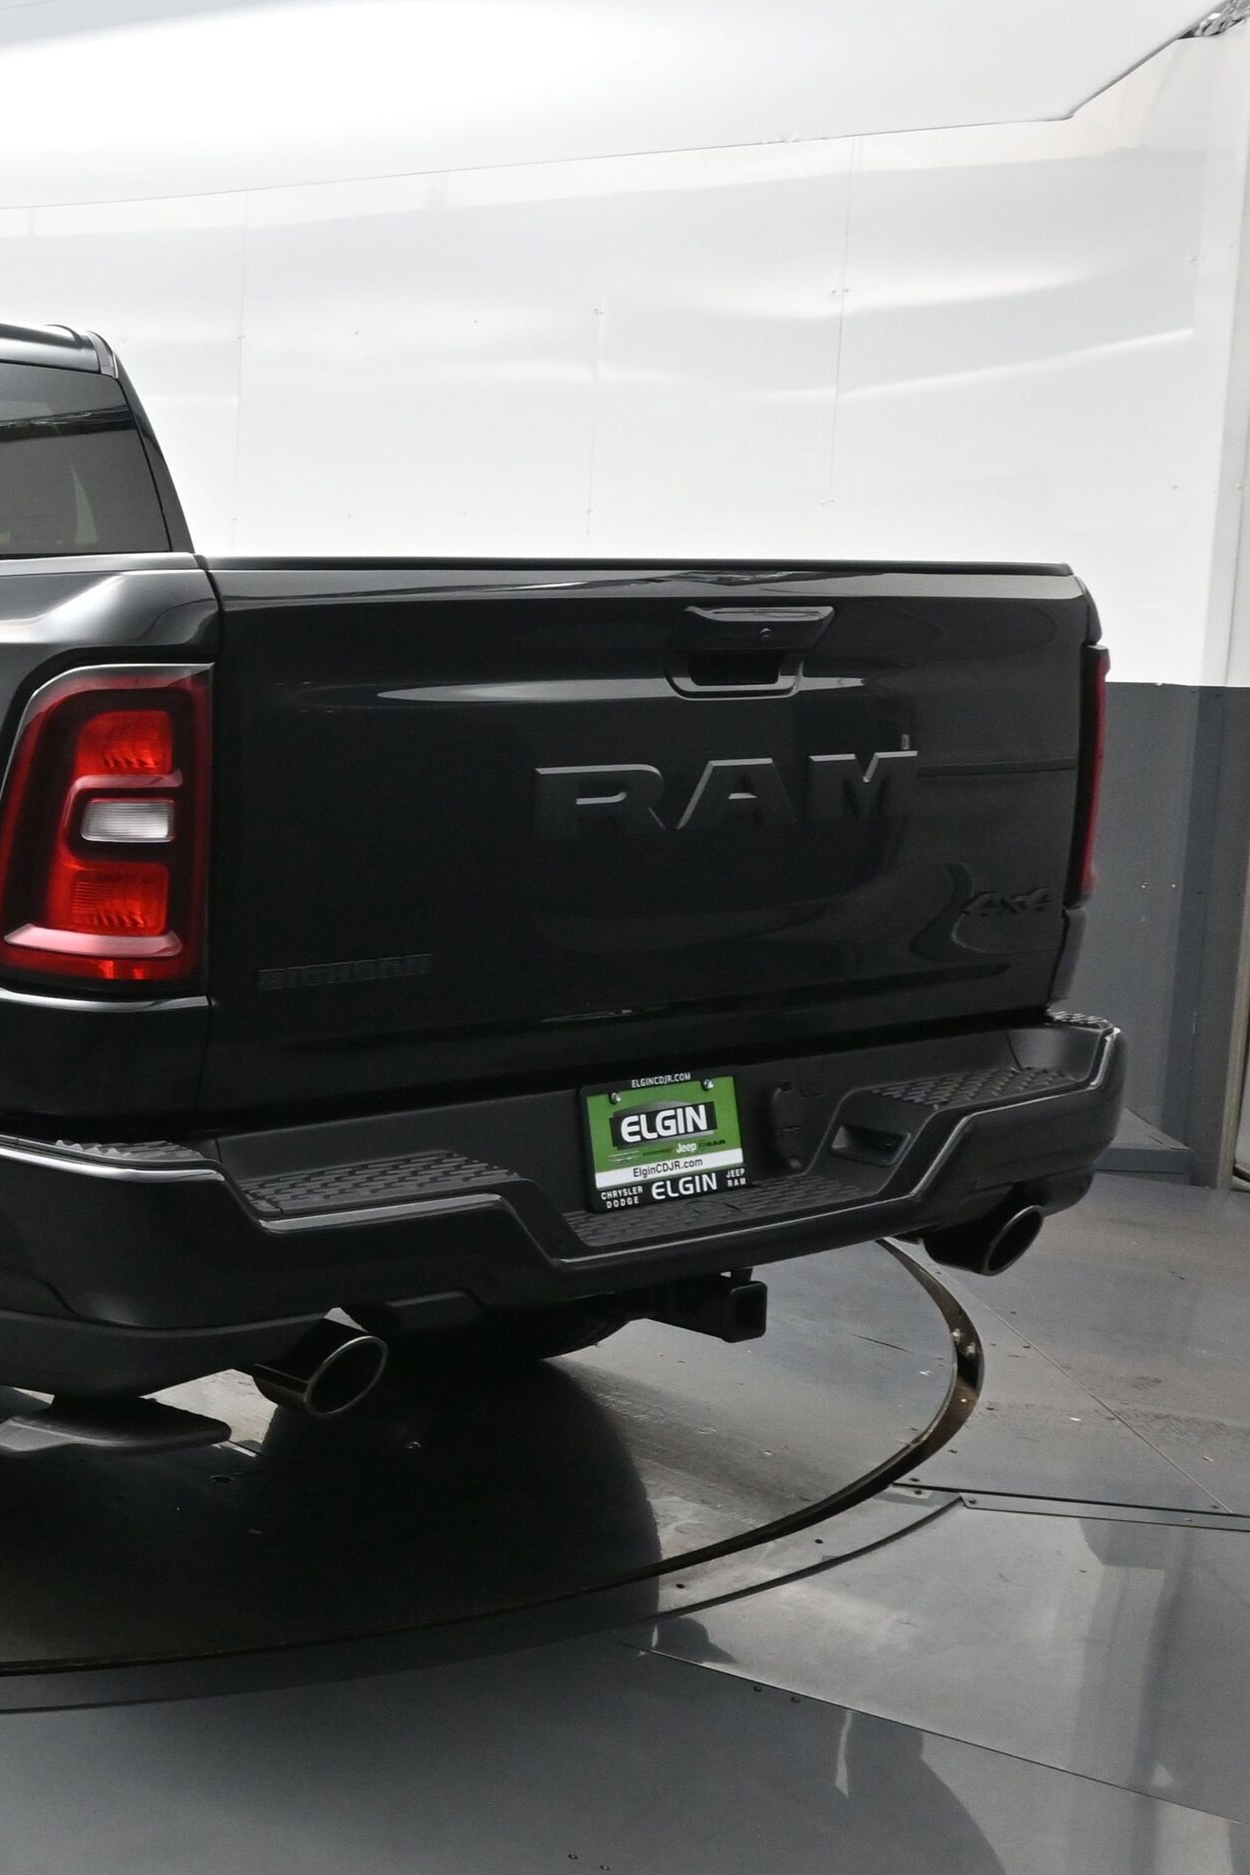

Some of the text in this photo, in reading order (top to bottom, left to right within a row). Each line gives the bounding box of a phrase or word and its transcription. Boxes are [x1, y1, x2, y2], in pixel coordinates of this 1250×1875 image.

[534, 750, 918, 838] RAM
[631, 1072, 691, 1088] ELGINCDJR.COM
[620, 1104, 708, 1143] ELGIN
[675, 1142, 697, 1154] Jeep
[632, 1157, 704, 1178] ElginCDJR.com
[726, 1168, 746, 1179] JEEP
[651, 1172, 717, 1200] ELGIN
[727, 1177, 747, 1187] RAM
[600, 1185, 643, 1200] CHRYSLER
[606, 1196, 639, 1209] DODGE
